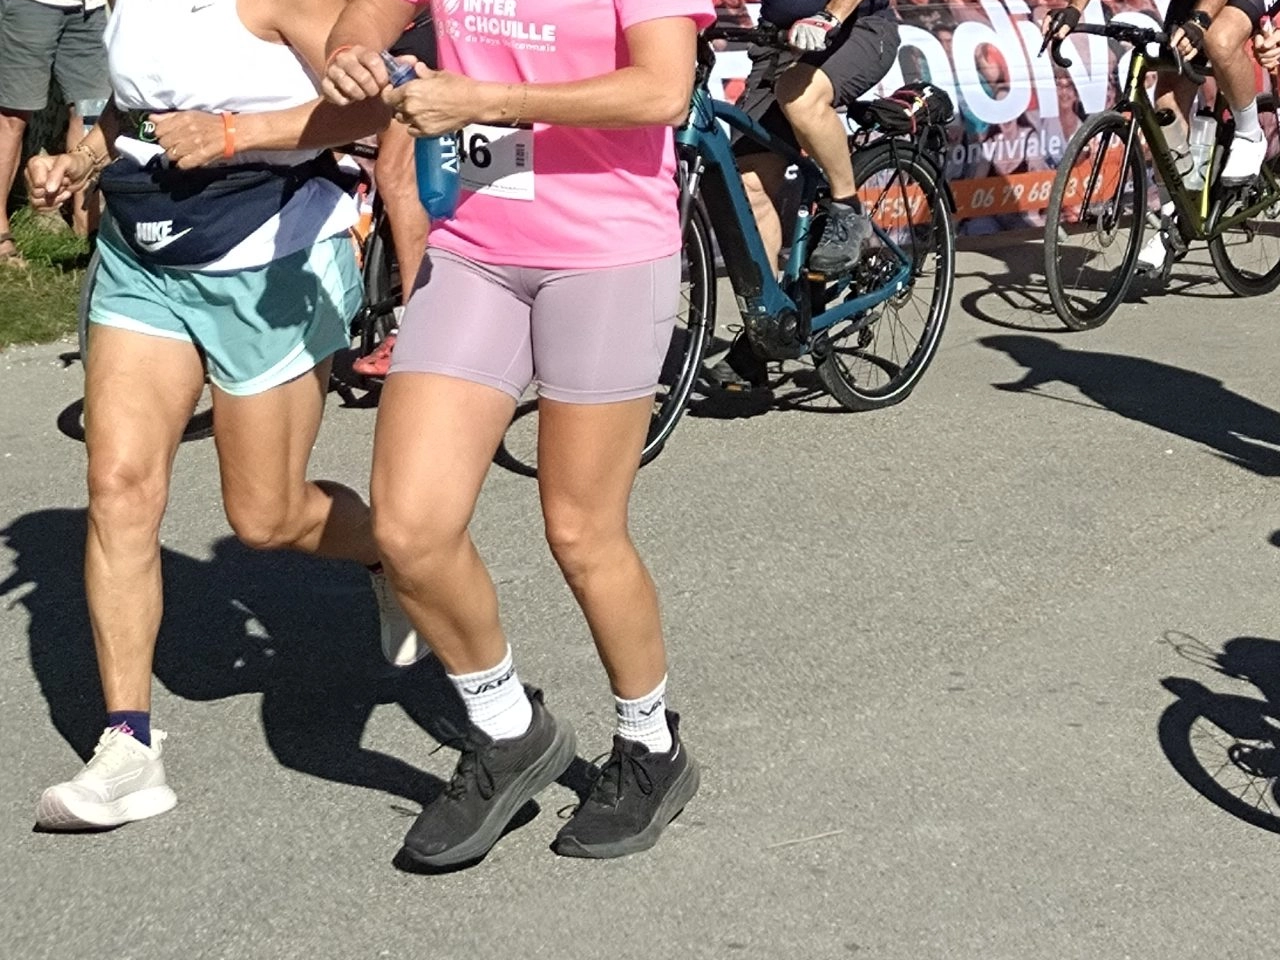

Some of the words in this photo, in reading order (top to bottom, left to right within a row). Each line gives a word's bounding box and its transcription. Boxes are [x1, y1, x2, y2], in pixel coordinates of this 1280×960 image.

[464, 15, 557, 41] CHOUILLE
[1027, 180, 1052, 201] 68
[135, 219, 174, 242] NIKE
